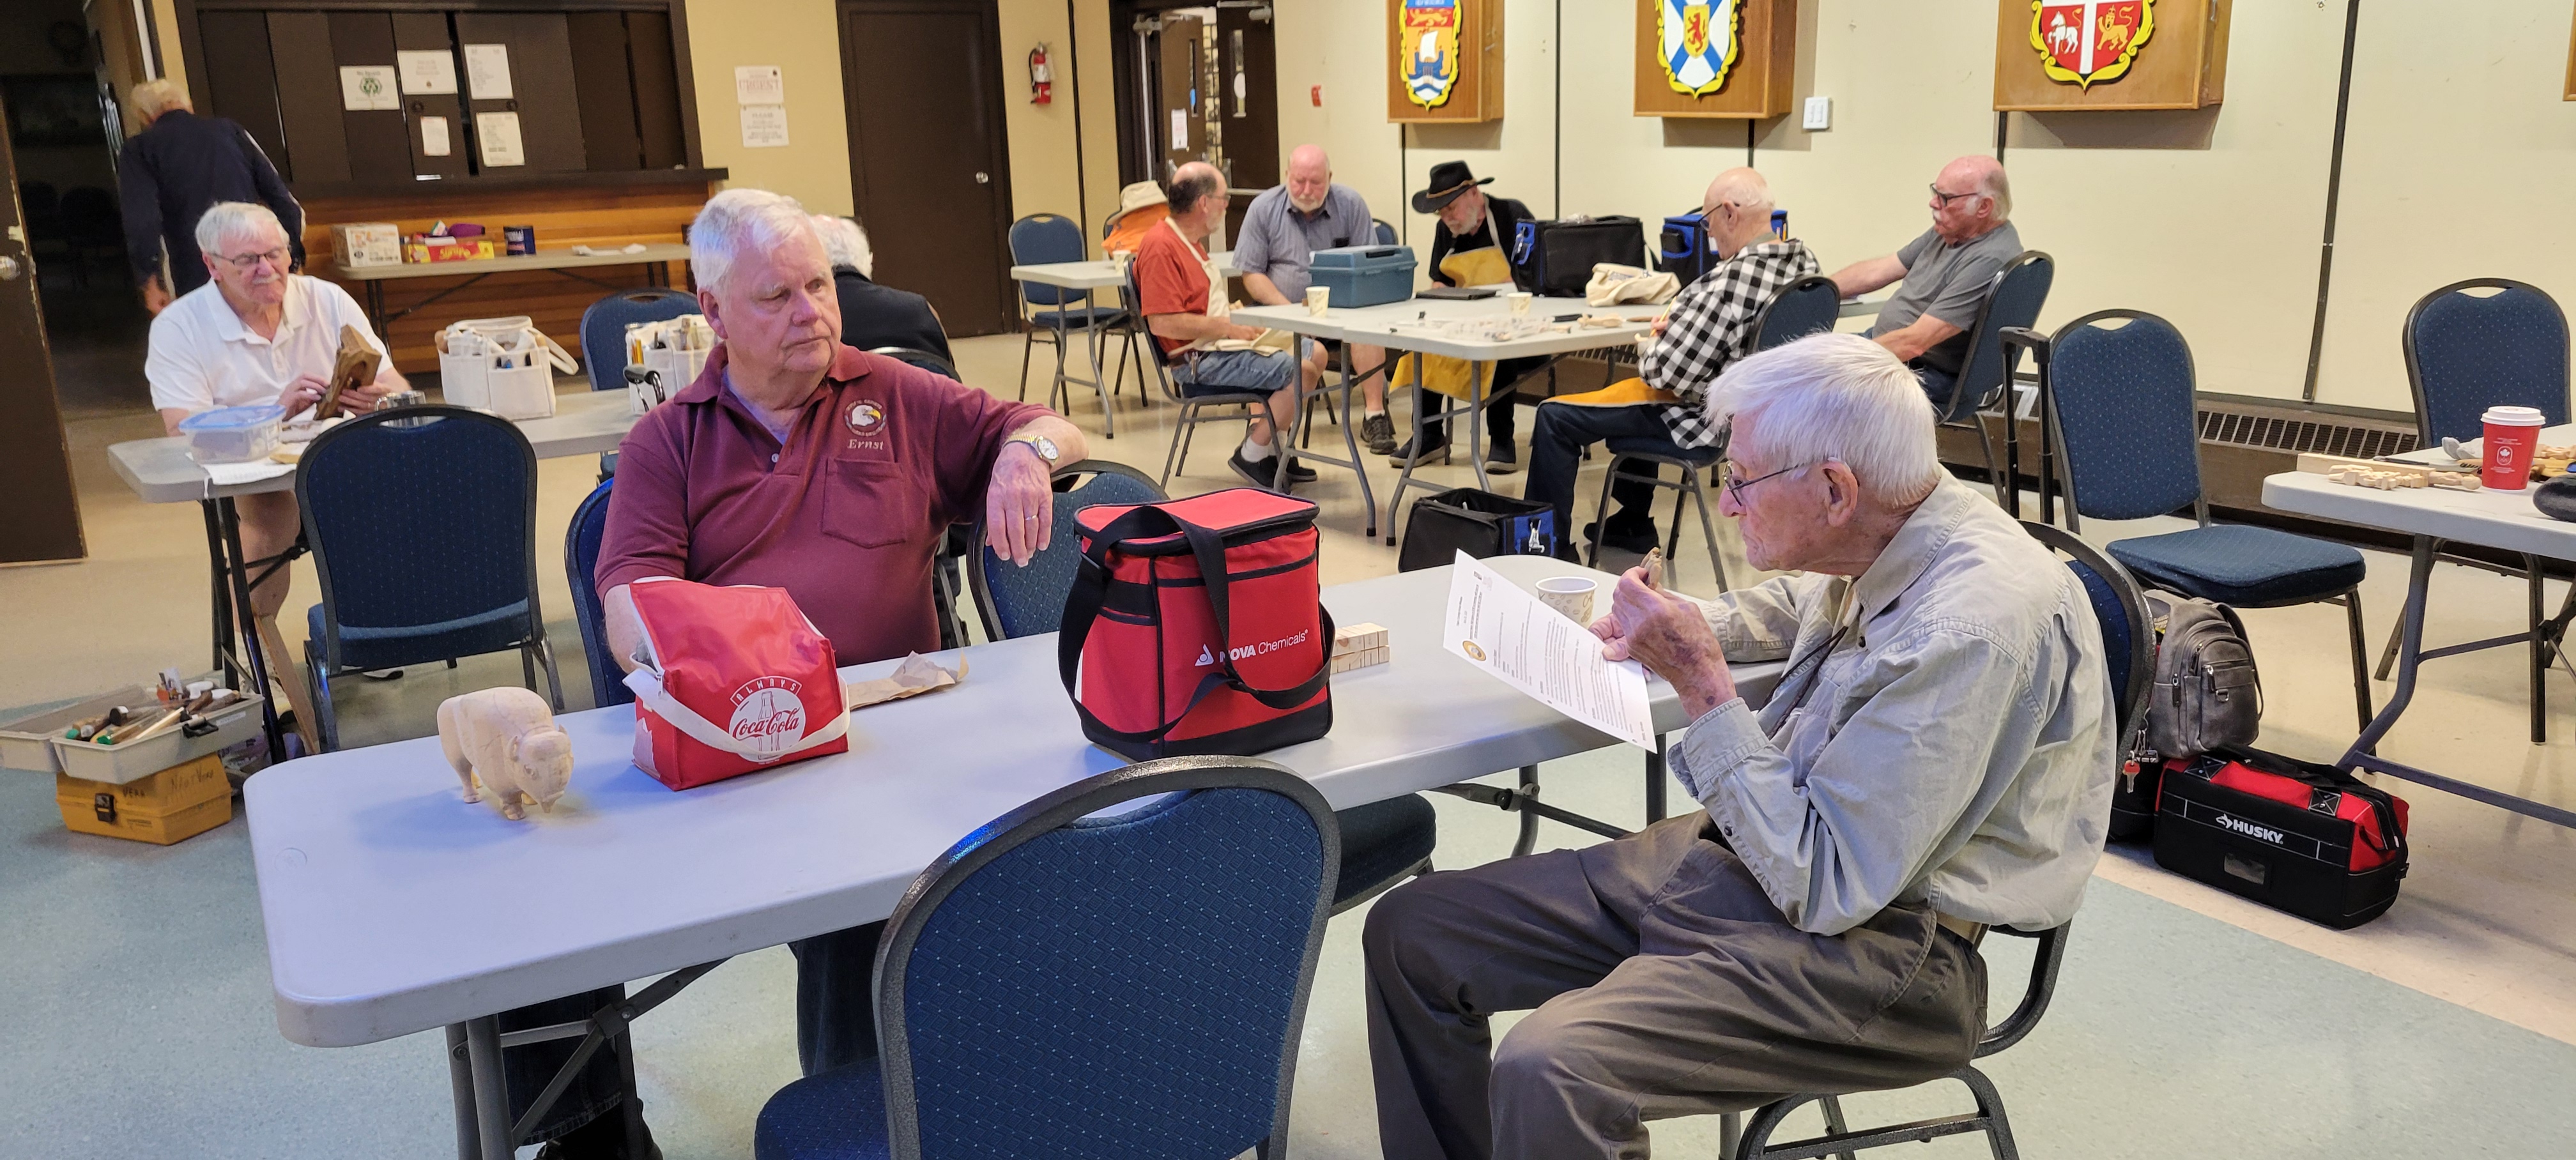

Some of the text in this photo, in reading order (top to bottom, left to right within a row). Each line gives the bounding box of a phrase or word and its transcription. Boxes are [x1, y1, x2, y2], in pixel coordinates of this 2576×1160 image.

[847, 439, 884, 450] Ernst
[1258, 630, 1306, 655] Chemicals
[736, 678, 797, 701] ALWAYS
[732, 706, 801, 741] Coca-Cola
[2233, 819, 2284, 844] HUSKY
